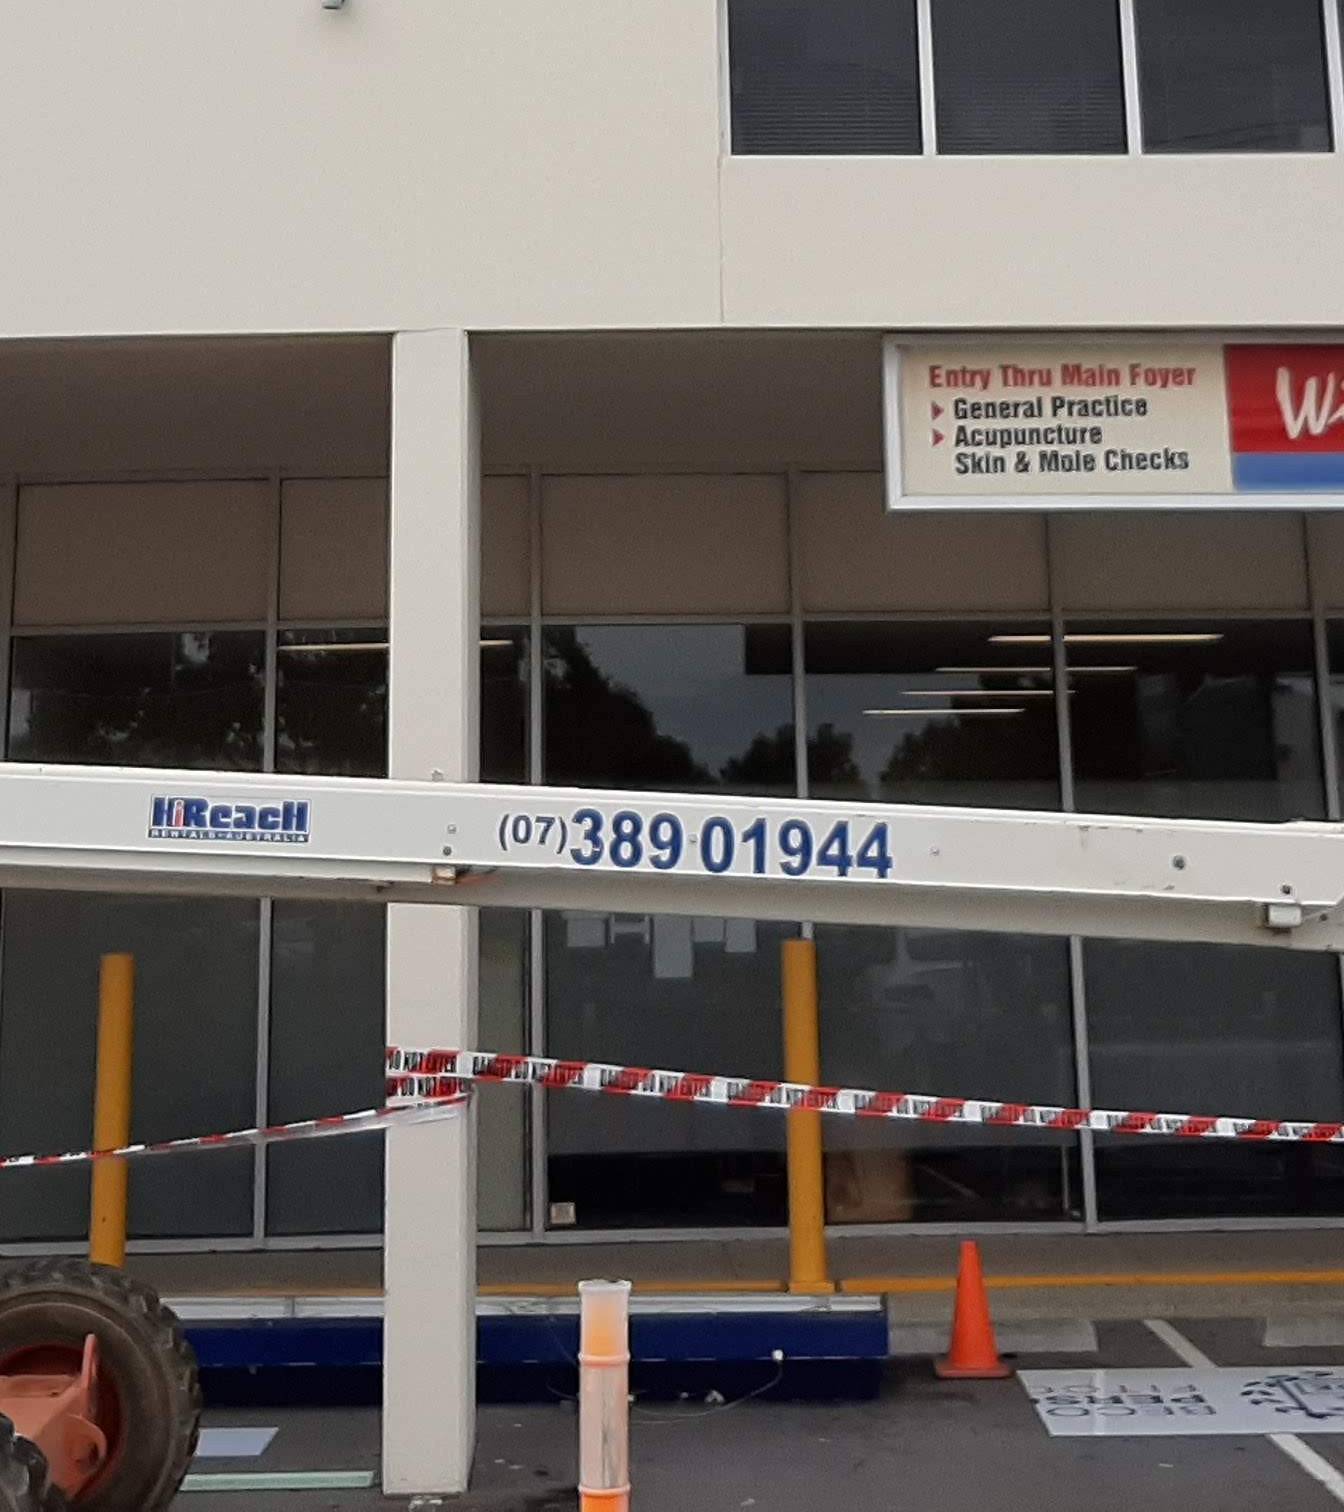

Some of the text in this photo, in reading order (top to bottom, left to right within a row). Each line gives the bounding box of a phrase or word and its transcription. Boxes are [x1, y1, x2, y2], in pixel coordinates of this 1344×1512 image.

[929, 364, 1197, 390] Entry Thru Main Foyer
[954, 394, 1149, 419] General Practice
[954, 423, 1103, 450] Acupuncture
[955, 447, 1190, 475] Skin & Mole Checks
[498, 807, 894, 880] (07) 389 01944
